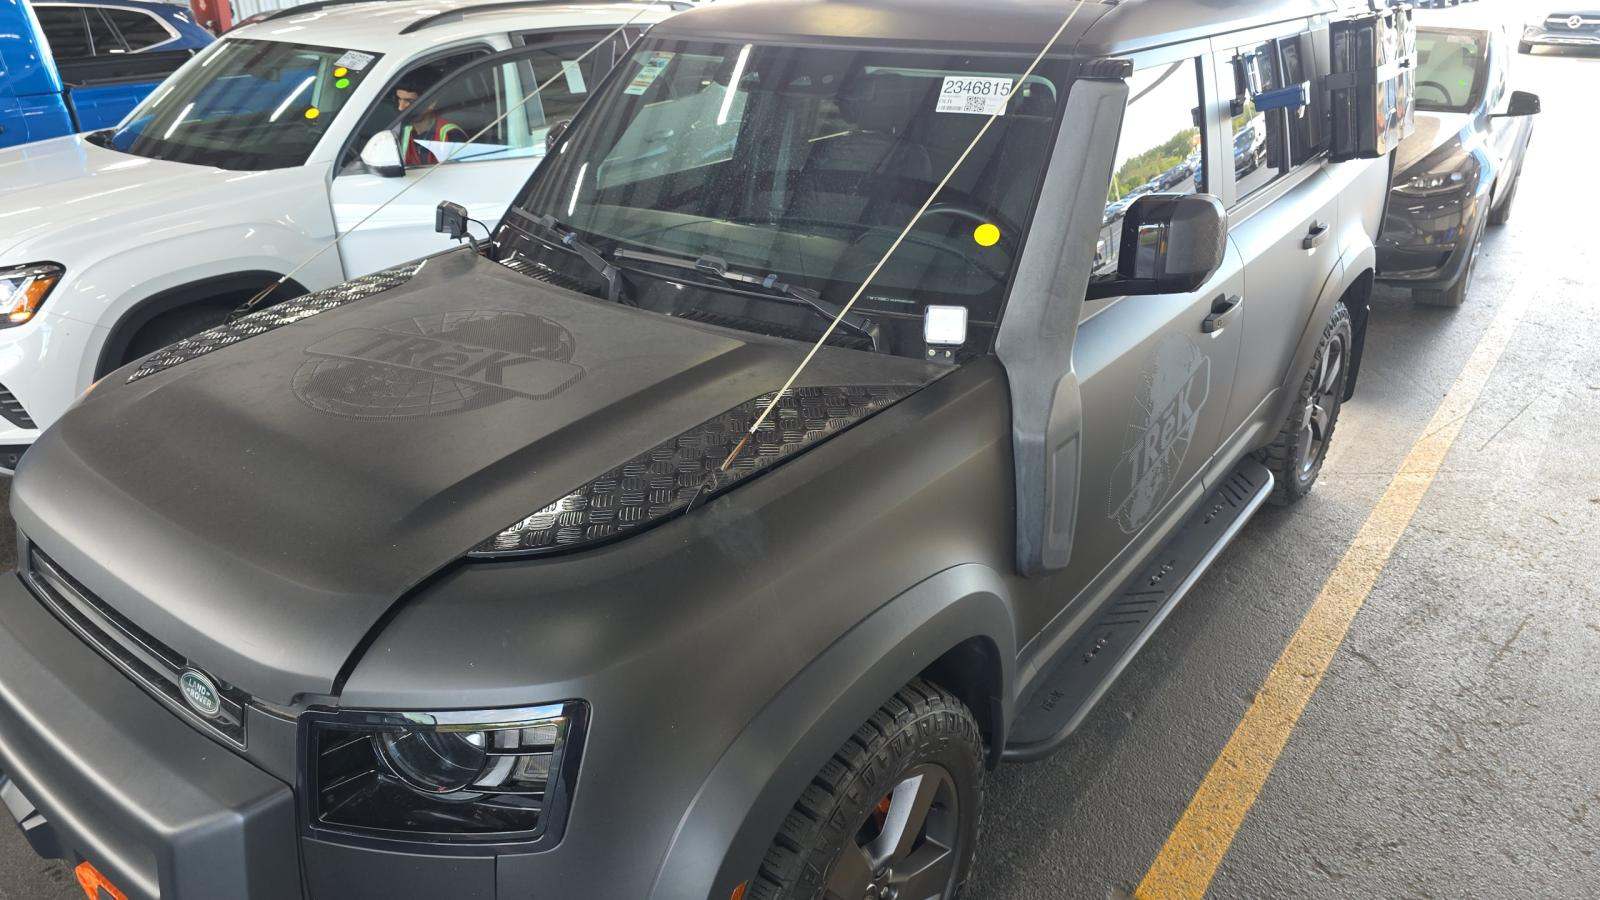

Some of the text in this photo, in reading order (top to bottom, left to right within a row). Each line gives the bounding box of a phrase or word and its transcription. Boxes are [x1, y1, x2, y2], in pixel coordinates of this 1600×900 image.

[943, 80, 1011, 96] 2346815
[188, 678, 207, 695] LAND
[189, 688, 212, 708] ROVER
